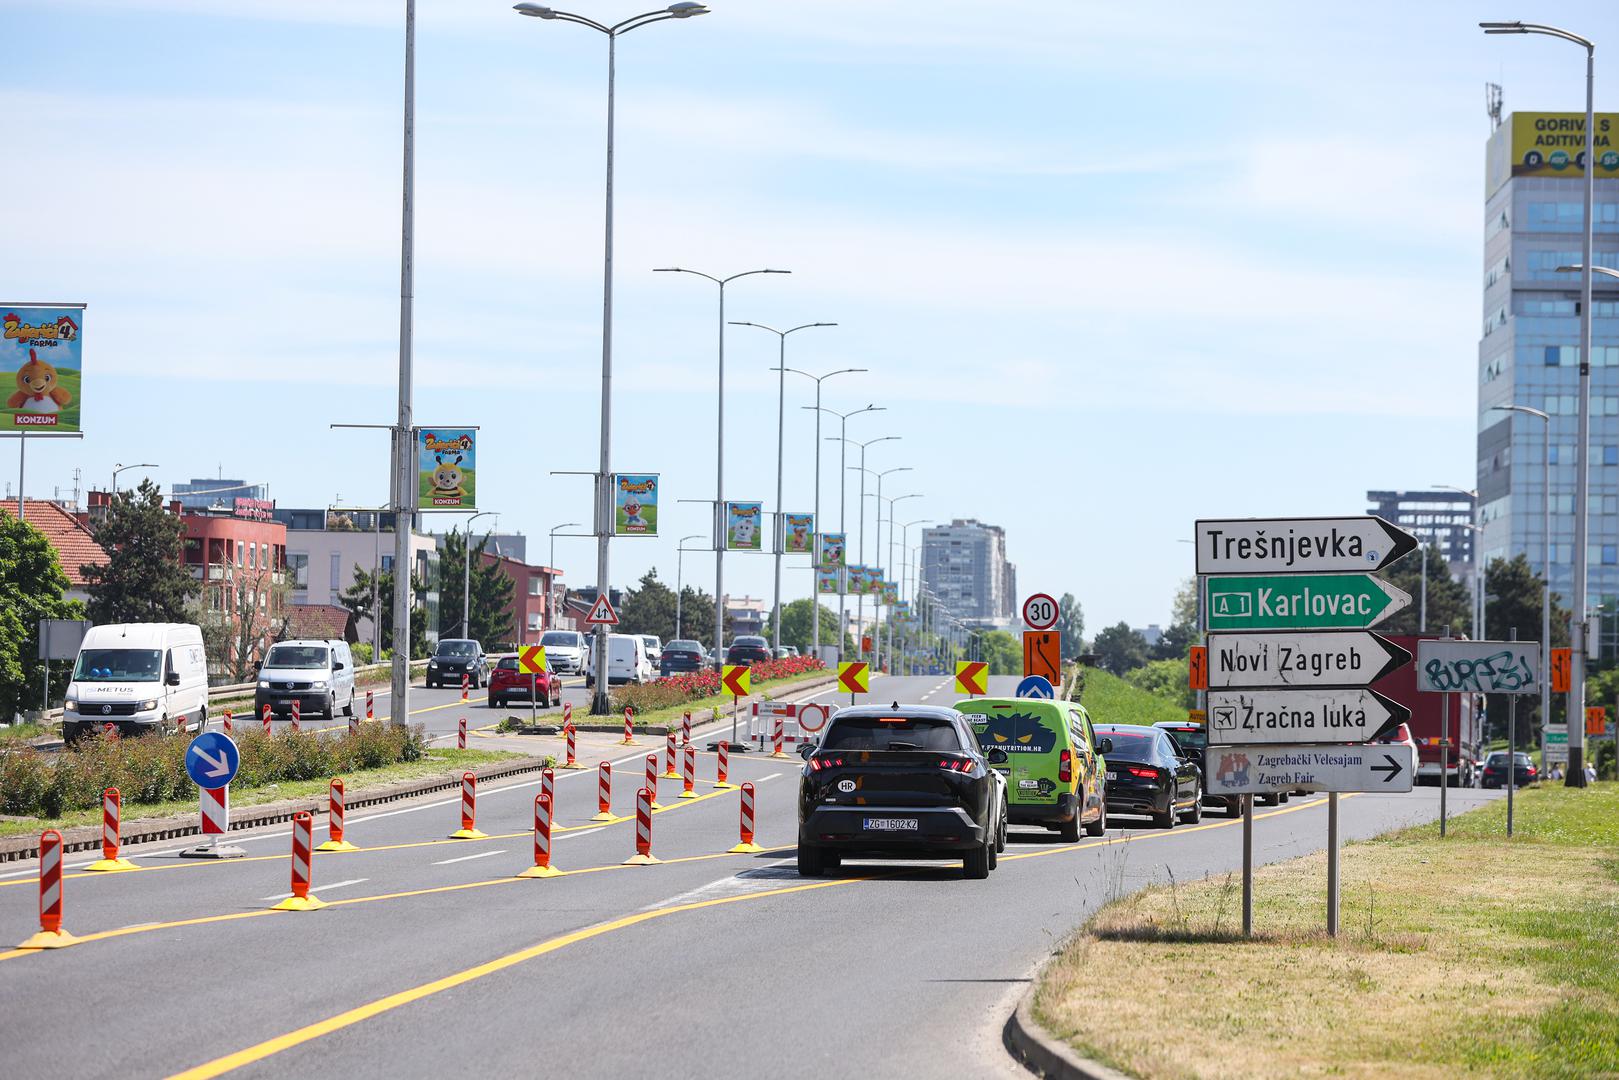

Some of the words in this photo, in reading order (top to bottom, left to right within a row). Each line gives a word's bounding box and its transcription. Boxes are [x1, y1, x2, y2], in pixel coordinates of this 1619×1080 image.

[1535, 119, 1595, 132] GORIV
[1600, 119, 1611, 132] S
[59, 325, 71, 339] 4
[16, 415, 56, 424] KONZUM
[1207, 528, 1363, 566] Trešnjevka
[1257, 587, 1372, 617] Karlovac
[1030, 602, 1051, 621] 30
[1220, 647, 1268, 672] Novi
[1279, 647, 1361, 677] Zagreb
[1241, 705, 1316, 729] Zračna
[1323, 704, 1366, 728] luka
[1257, 754, 1312, 769] Zagrebački
[1314, 753, 1363, 769] Velesajam
[841, 782, 853, 790] HR
[1258, 772, 1292, 787] Zagreb
[1294, 771, 1315, 784] Fair
[869, 819, 880, 829] ZG
